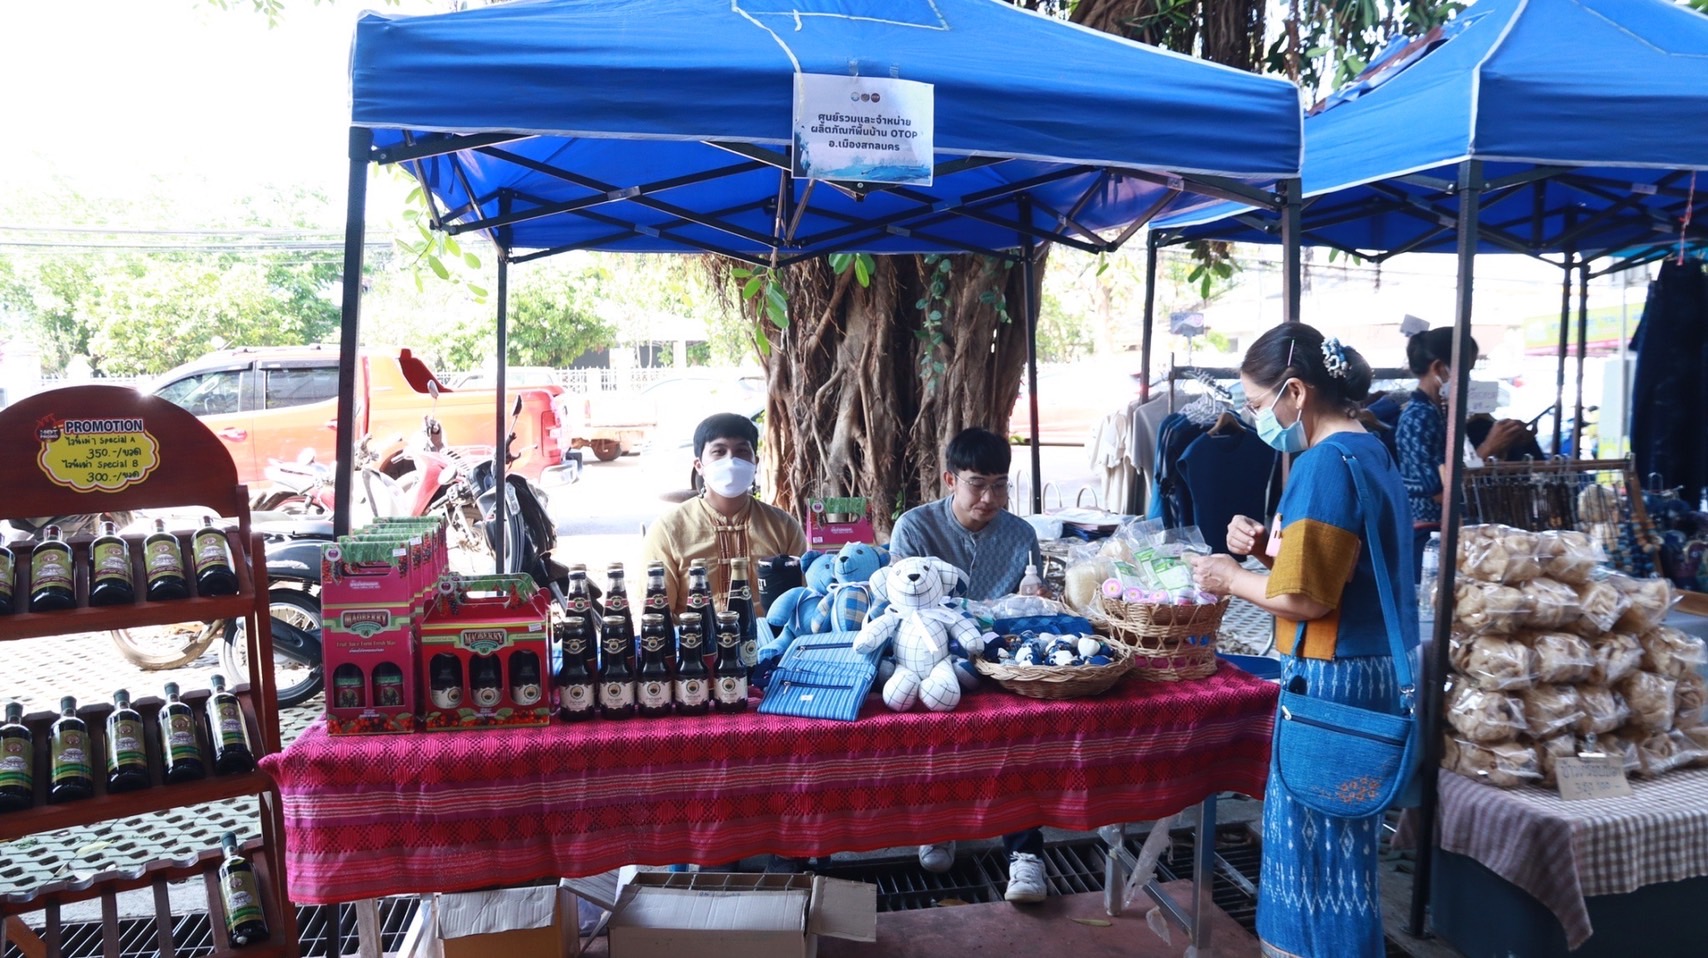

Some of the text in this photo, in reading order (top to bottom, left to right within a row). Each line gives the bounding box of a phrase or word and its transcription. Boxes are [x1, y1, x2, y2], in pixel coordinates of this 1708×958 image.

[818, 112, 912, 126] ศูนย์รวมและจำหน่าย
[811, 122, 918, 139] ผลิตภัณฑ์พื้นบ้าน OTOP
[828, 138, 900, 151] อ.เมืองสกลนคร
[65, 419, 143, 433] PROMOTION
[132, 459, 139, 467] B
